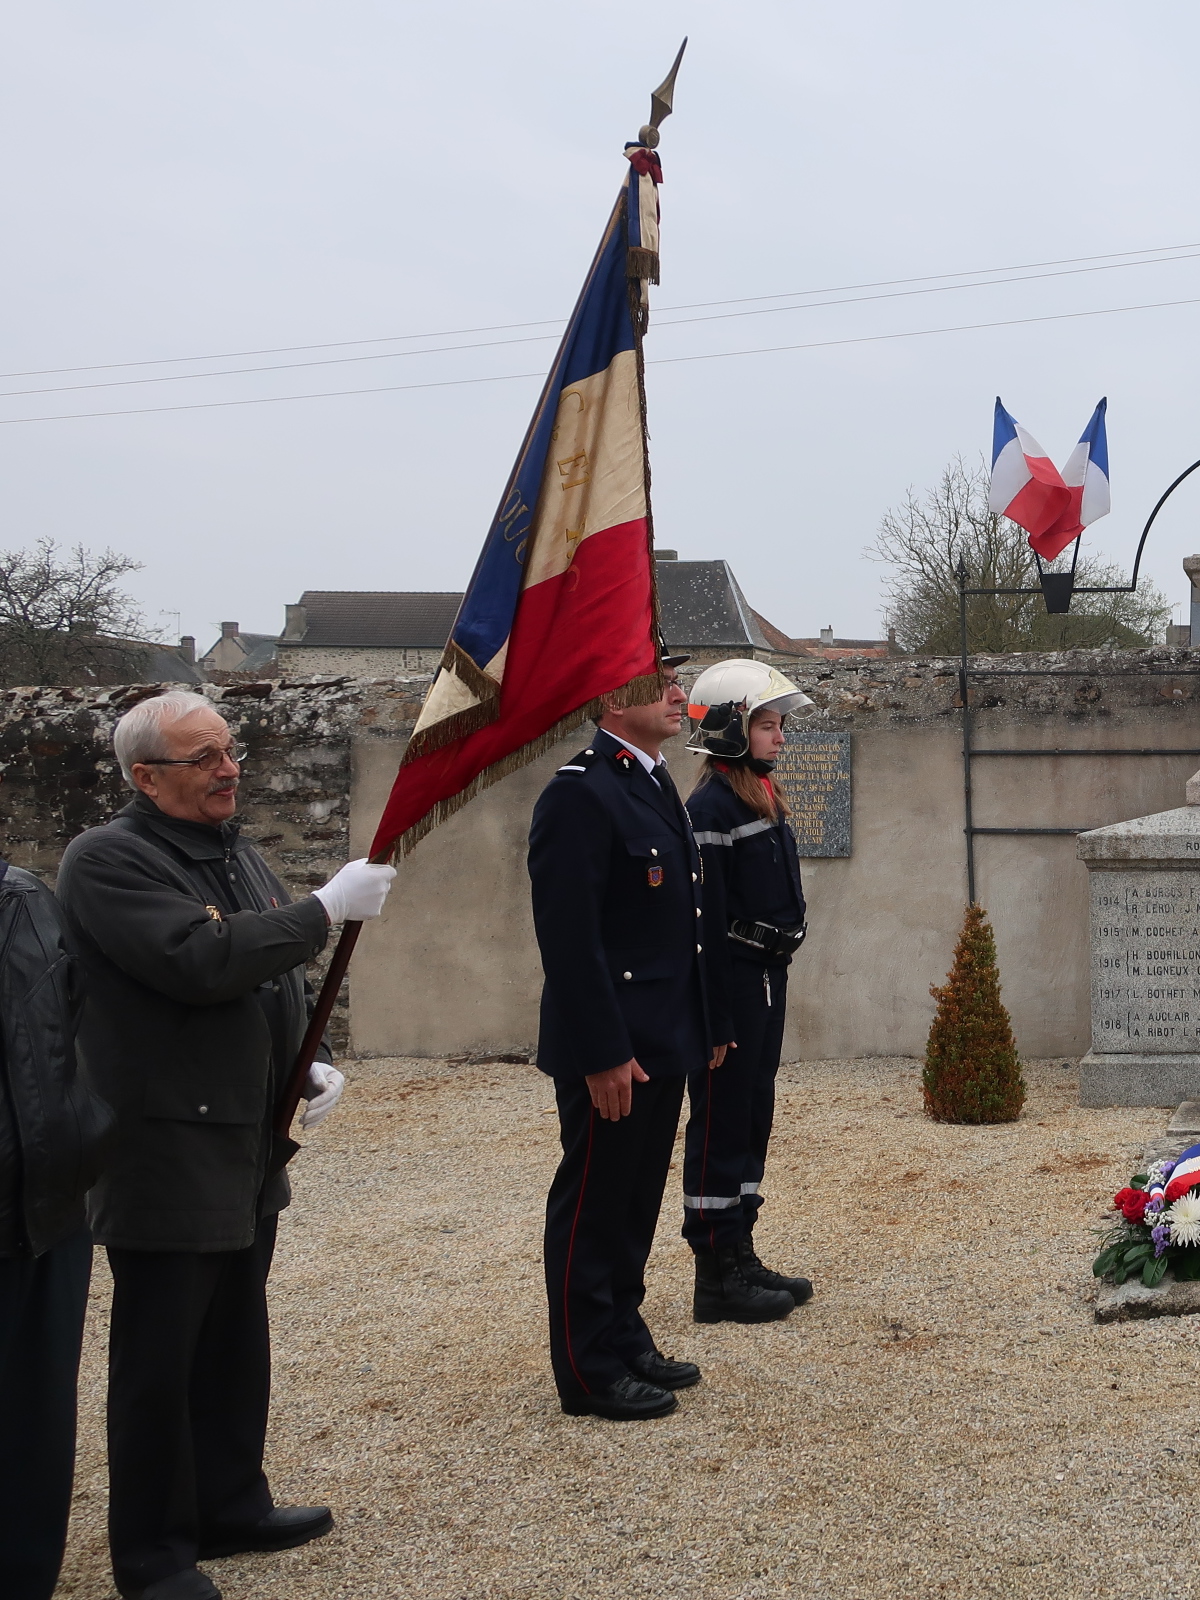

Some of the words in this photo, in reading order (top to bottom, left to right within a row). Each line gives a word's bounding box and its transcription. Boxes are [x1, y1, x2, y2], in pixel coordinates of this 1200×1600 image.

[1098, 896, 1120, 906] 1914
[1145, 903, 1176, 914] LEROY
[1098, 927, 1120, 937] 1915
[1145, 927, 1184, 937] COCHET
[1099, 959, 1121, 969] 1916
[1146, 965, 1189, 976] LIGNEUX
[1099, 988, 1121, 999] 1917
[1146, 988, 1185, 999] BOTHET
[1100, 1020, 1122, 1030] 1918
[1148, 1011, 1190, 1022] AUCLAIR
[1147, 1026, 1176, 1037] RIBOT
